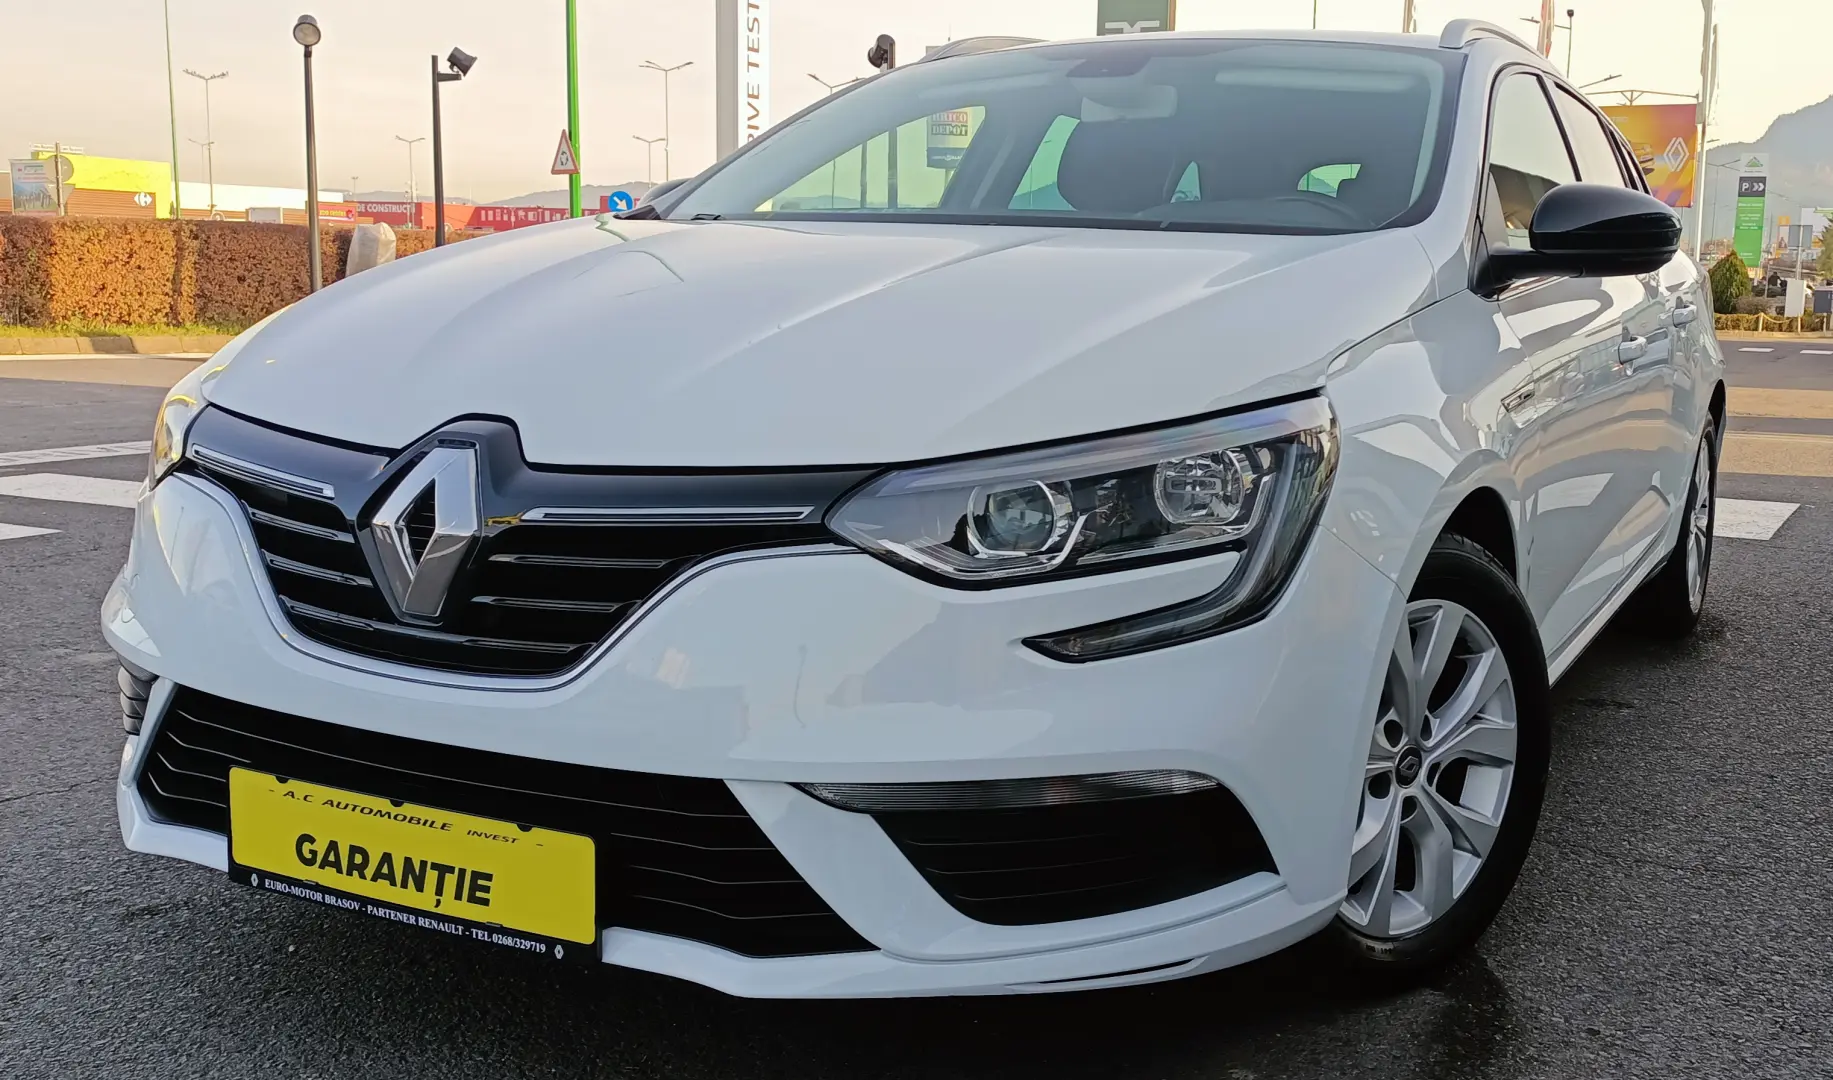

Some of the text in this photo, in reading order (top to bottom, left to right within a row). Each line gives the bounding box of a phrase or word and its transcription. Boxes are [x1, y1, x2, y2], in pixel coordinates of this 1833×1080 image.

[747, 0, 760, 73] TEST
[283, 790, 315, 803] A.C
[322, 799, 454, 832] AUTOMOBILE
[466, 829, 520, 844] INVEST
[295, 833, 494, 908] GARANȚIE
[264, 878, 323, 902] EURO-MOTOR
[324, 894, 360, 911] BRASOV
[367, 904, 417, 925] PARTENER
[418, 916, 464, 935] RENAULT
[471, 928, 491, 942] TEL
[492, 931, 546, 954] 0268/329719
